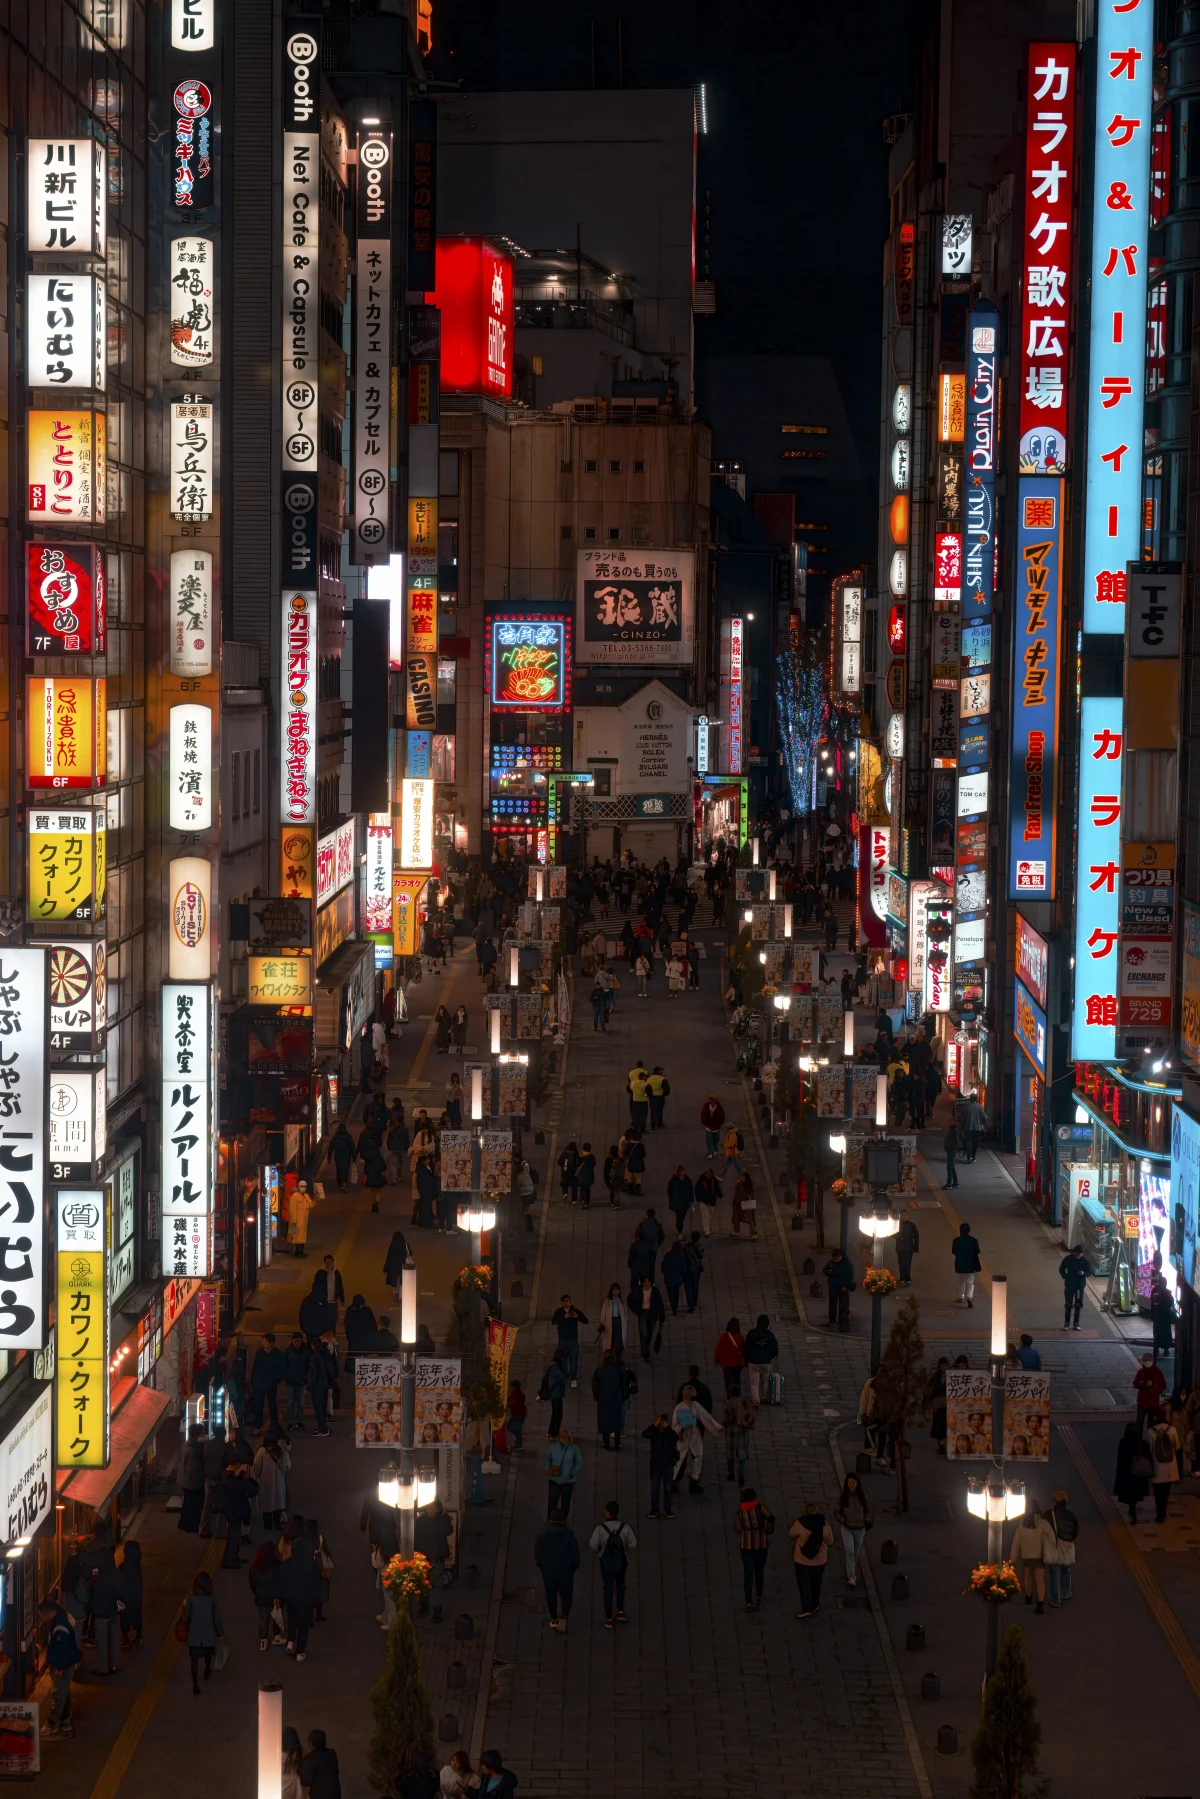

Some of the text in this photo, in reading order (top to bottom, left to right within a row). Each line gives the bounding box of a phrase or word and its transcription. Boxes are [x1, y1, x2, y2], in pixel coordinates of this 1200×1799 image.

[286, 32, 317, 122] Booth
[174, 117, 195, 206] ミッキーハウス
[292, 146, 310, 184] Net
[44, 144, 77, 249] 川新ビル
[360, 139, 389, 222] Booth
[292, 192, 310, 247] Cafe
[1024, 57, 1070, 410] カラオケ歌広場
[948, 219, 966, 268] ダーツ
[292, 254, 310, 270] &
[365, 250, 382, 352] ネットカフェ
[1094, 0, 1143, 604] オケ&パーティー館
[46, 279, 75, 384] にいむら
[288, 278, 310, 371] Capsule
[193, 335, 210, 350] 4F
[365, 362, 380, 378] &
[183, 394, 203, 403] 5F
[951, 382, 963, 433] 鳥貴族
[363, 386, 381, 456] カプセル
[51, 420, 74, 515] ととりこ
[943, 457, 960, 511] 山内農場
[32, 485, 43, 508] 8F
[1026, 501, 1052, 526] 薬
[284, 483, 315, 570] Booth
[415, 502, 426, 543] 生ビール
[966, 489, 990, 587] SHINJUKU
[585, 552, 626, 561] ブランド品
[596, 563, 678, 578] 売るのも 買うのも
[949, 546, 961, 578] 焼肉屋
[413, 578, 431, 588] 4F
[412, 592, 433, 634] 麻雀
[1023, 541, 1054, 706] マツモトキヨシ
[35, 637, 51, 649] 7F
[288, 612, 309, 690] カラオケ
[620, 631, 660, 639] GINZO
[407, 657, 436, 726] CASINO
[57, 688, 77, 767] 鳥貴族
[183, 719, 198, 764] 鉄板焼
[53, 777, 68, 787] 6F
[286, 708, 311, 822] まねきねこ
[1023, 730, 1045, 842] Shop Free Tax
[35, 815, 87, 830] 質・買取
[873, 831, 887, 886] トラノコ
[393, 879, 422, 888] カラオケ
[1021, 875, 1042, 885] 免税
[1084, 728, 1123, 1026] カラオケ館
[1125, 870, 1173, 886] つり具
[76, 909, 91, 918] 5F
[1124, 906, 1153, 914] New
[1135, 914, 1170, 922] Used
[261, 961, 298, 978] 雀荘
[1126, 972, 1167, 982] EXCHANGE
[250, 983, 308, 997] ワイワイクラブ
[1129, 1009, 1163, 1021] 729
[50, 1033, 72, 1049] 4F
[174, 994, 197, 1074] 喫茶室
[170, 1083, 202, 1204] ルノアール
[53, 1164, 71, 1178] 3F
[66, 1230, 97, 1241] 買取
[173, 1217, 188, 1276] 磯丸水産
[69, 1291, 91, 1460] カワノ・クォーク
[356, 1363, 383, 1377] 忘年
[356, 1374, 400, 1388] カンパイ!
[415, 1374, 461, 1388] カンパイ!
[416, 1364, 444, 1377] 忘年
[948, 1374, 973, 1387] 忘年
[1006, 1376, 1033, 1388] 忘年
